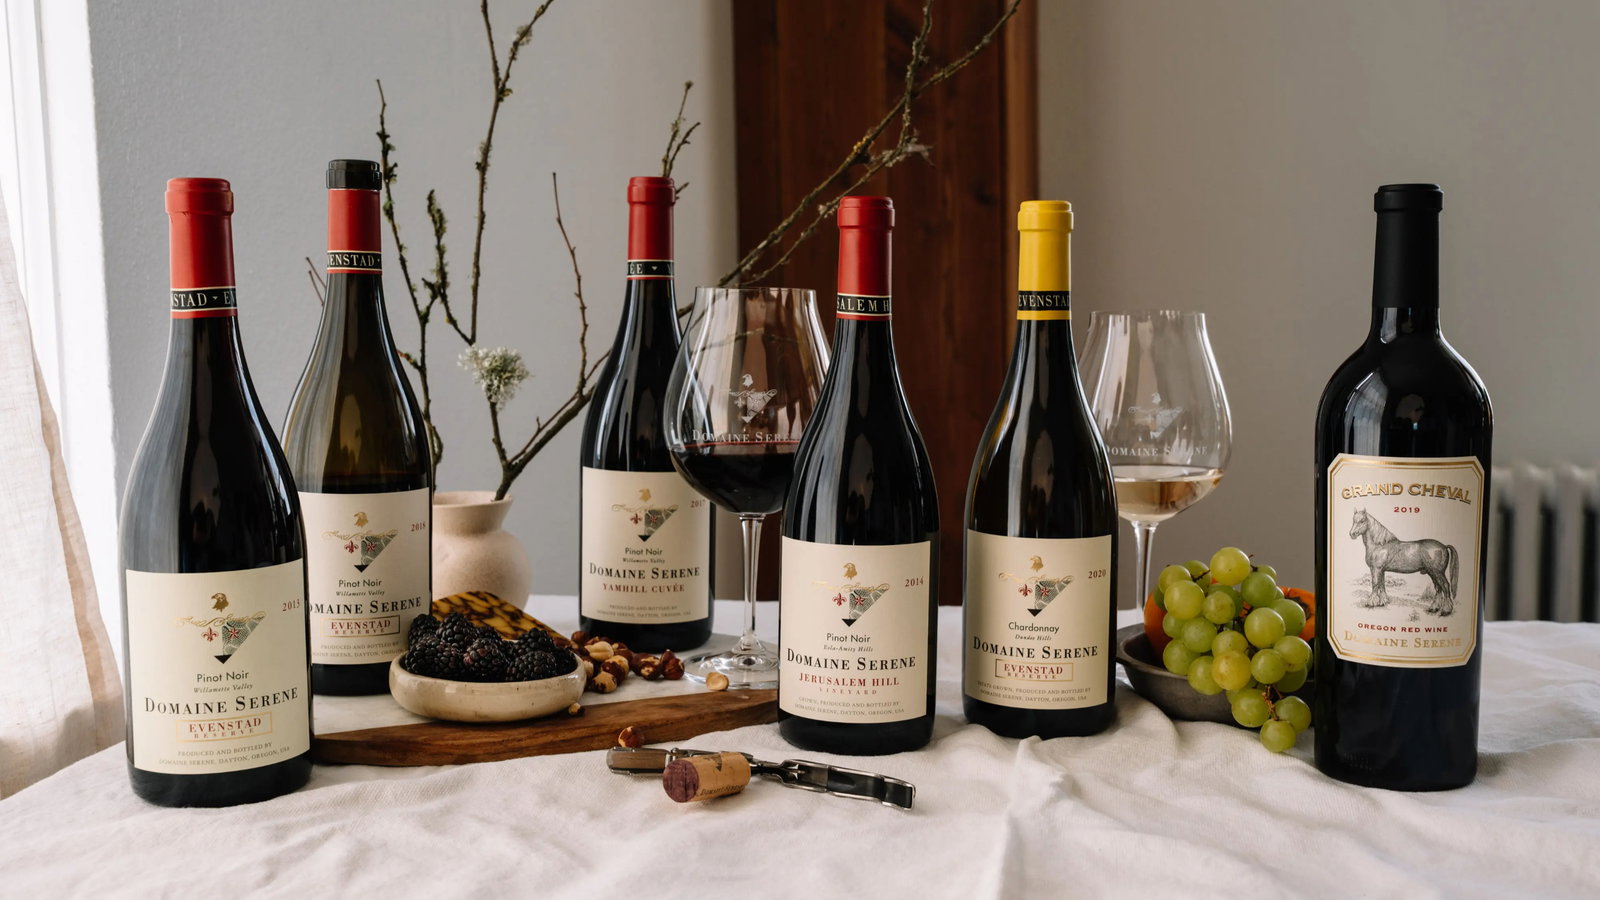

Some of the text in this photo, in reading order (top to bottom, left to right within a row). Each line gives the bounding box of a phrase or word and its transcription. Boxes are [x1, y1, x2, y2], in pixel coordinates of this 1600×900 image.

[1341, 483, 1472, 505] GRAND CHEVAL
[1394, 506, 1420, 514] 2019
[625, 547, 663, 556] Pinot Noir
[589, 562, 700, 580] DOMAINE SERENE
[1087, 569, 1107, 579] 2020
[338, 578, 382, 588] Pinot Noir
[603, 582, 685, 593] YAMHILL CUVÉE
[904, 576, 924, 588] 2014
[368, 589, 385, 598] Valley
[369, 596, 422, 614] SERENE
[331, 618, 391, 630] EVENSTAD
[1008, 621, 1060, 635] Chardonnay
[1358, 622, 1397, 632] OREGON
[334, 627, 385, 635] RESERVE
[826, 632, 871, 643] Pinot Noir
[1414, 638, 1464, 649] SERENE
[823, 644, 856, 653] Eola-Amity
[973, 636, 1098, 660] DOMAINE SERENE
[787, 648, 916, 671] DOMAINE SERENE
[1003, 663, 1063, 675] EVENSTAD
[197, 670, 249, 683] Pinot Noir
[799, 672, 900, 687] JERUSALEM HILL
[1007, 672, 1056, 680] RESERVE
[193, 682, 254, 695] Willamette Valley
[818, 686, 877, 695] VINEYARD
[145, 687, 299, 716] DOMAINE SERENE
[189, 717, 262, 733] EVENSTAD
[194, 728, 254, 740] RESERVE
[216, 749, 232, 757] AND
[234, 744, 263, 755] BOTTLED
[264, 742, 273, 750] BY
